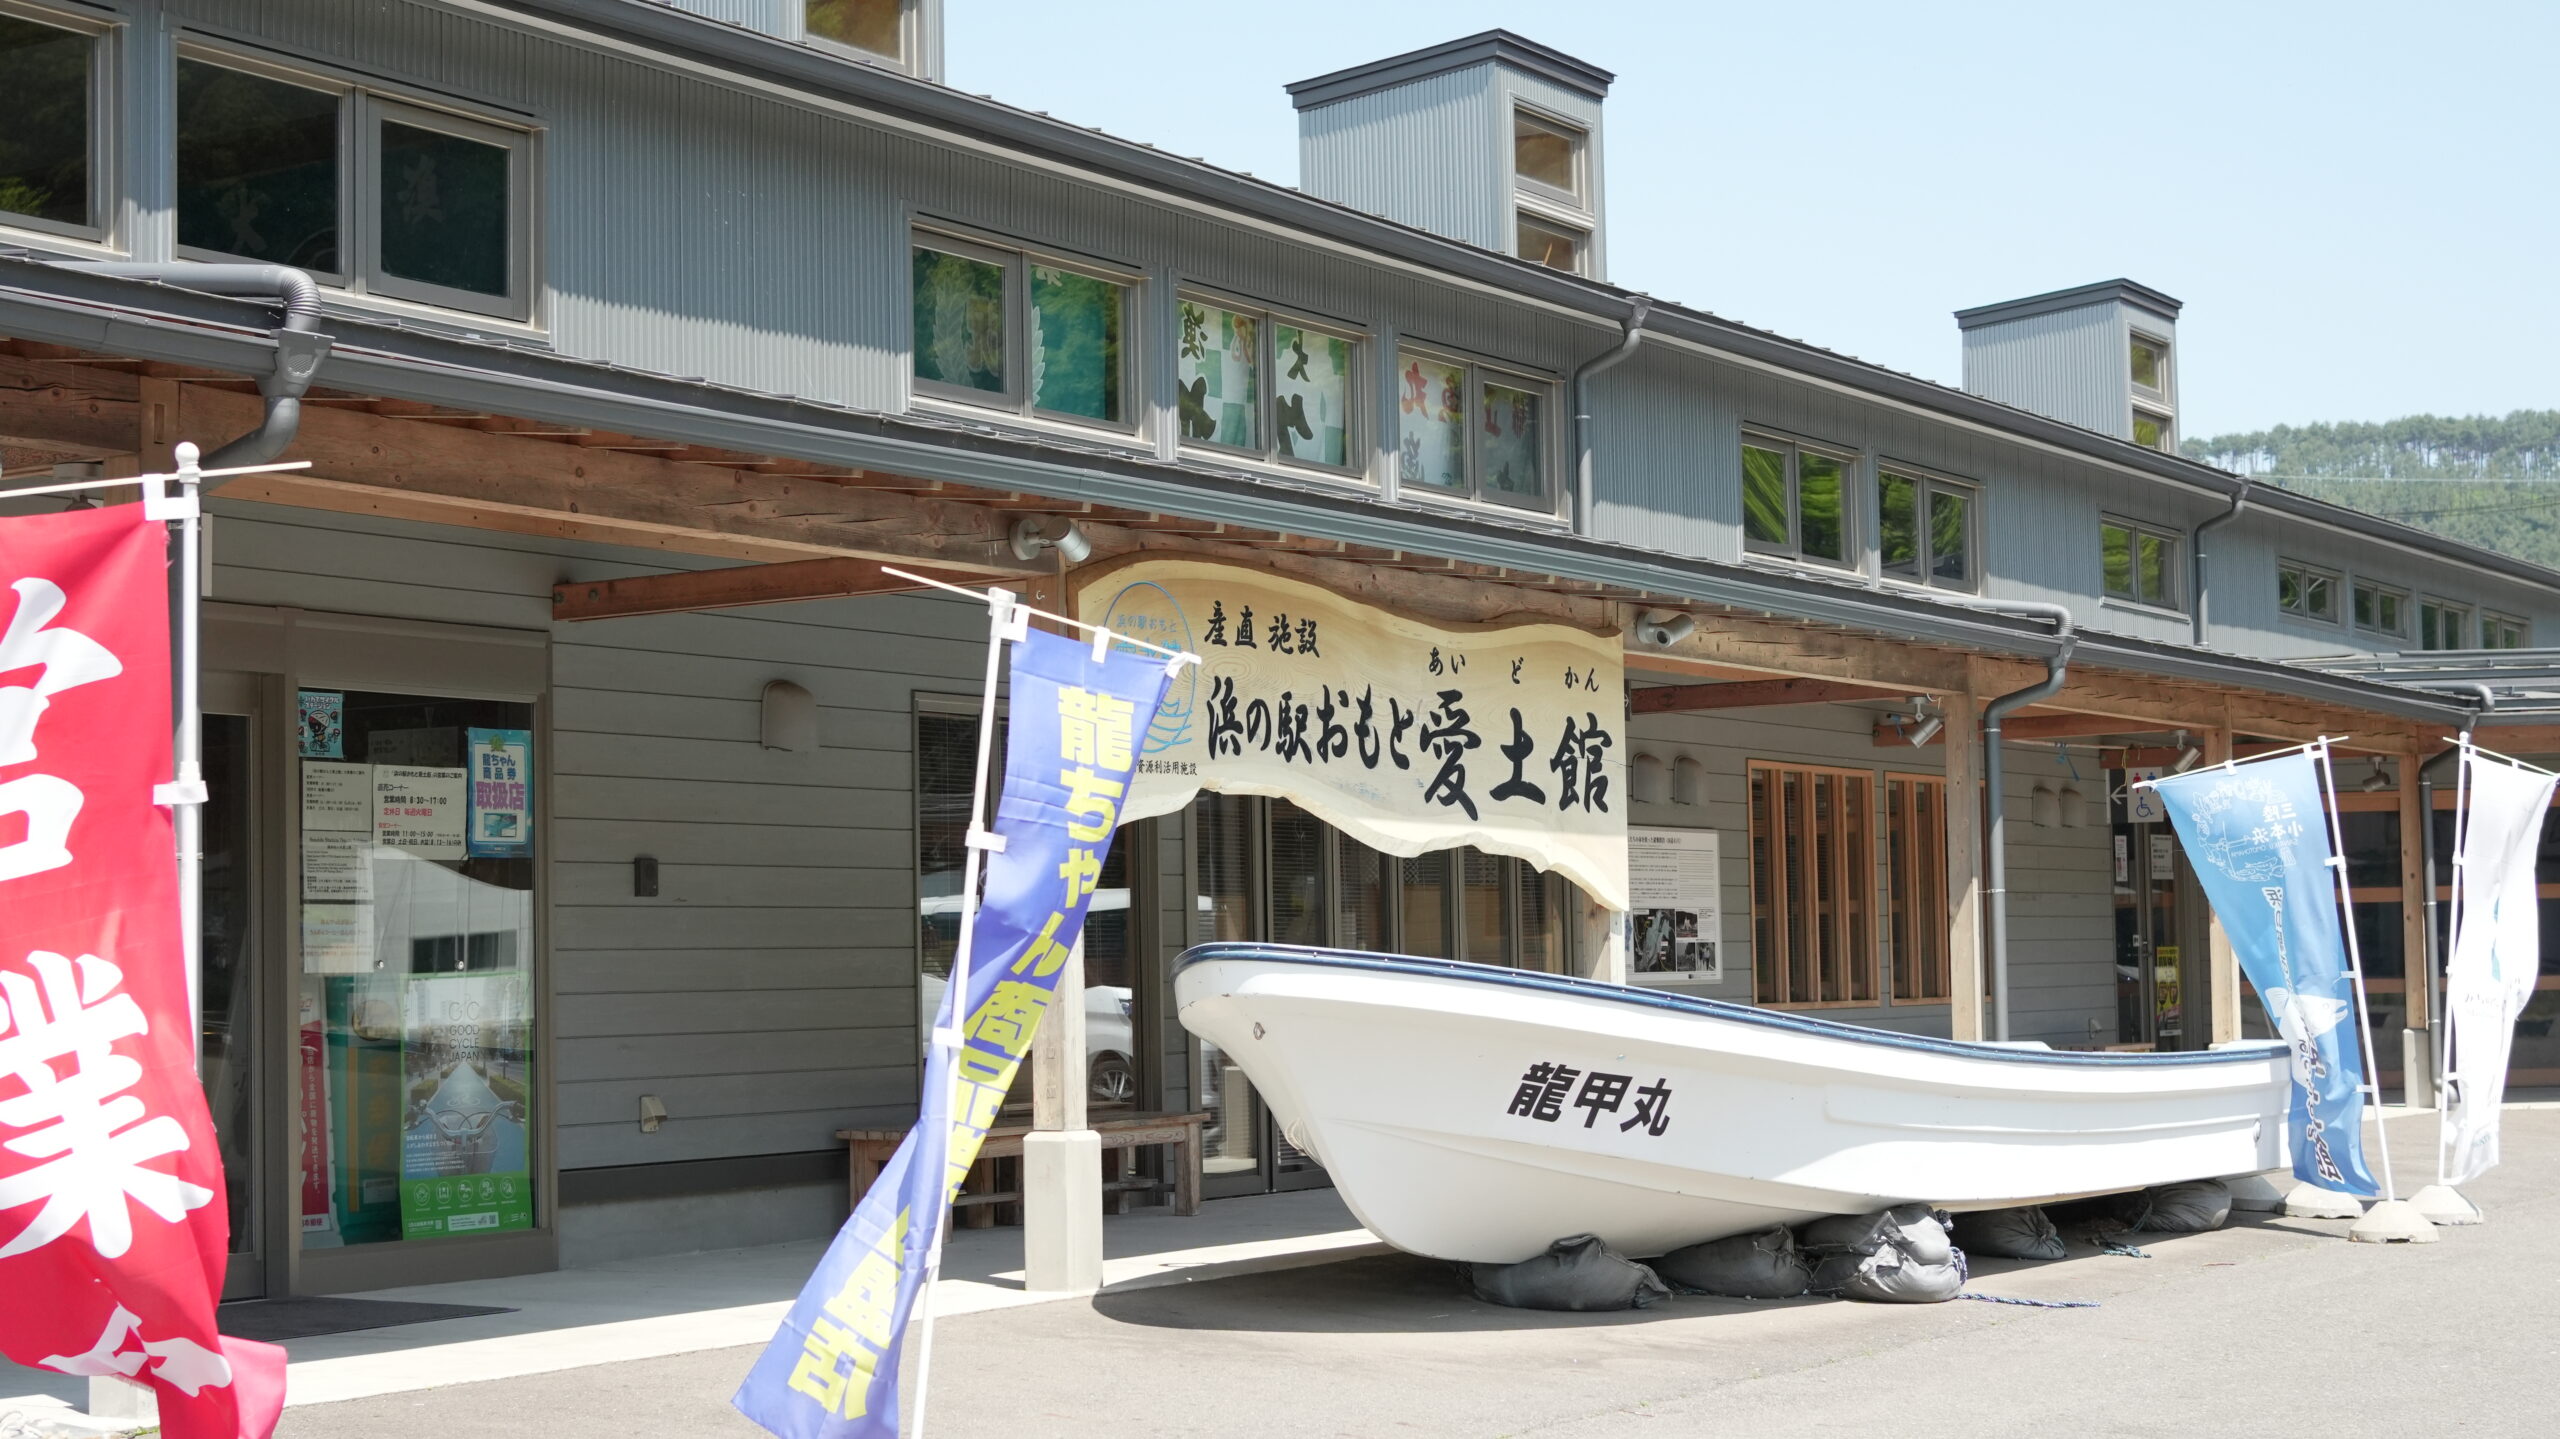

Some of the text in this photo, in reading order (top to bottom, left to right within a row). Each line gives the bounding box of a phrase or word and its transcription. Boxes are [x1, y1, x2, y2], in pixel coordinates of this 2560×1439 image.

[1204, 601, 1320, 658] 産直施設
[482, 753, 516, 767] 龍ちゃん
[483, 766, 517, 781] 商品券
[1134, 759, 1198, 776] 資源利活用施設
[383, 795, 407, 804] 営業時間
[476, 781, 525, 811] 取扱店
[383, 807, 401, 816] 定休日
[449, 1025, 480, 1036] GOOD
[449, 1037, 480, 1049] CYCLE
[449, 1051, 480, 1063] JAPAN
[1506, 1061, 1673, 1137] 龍甲丸
